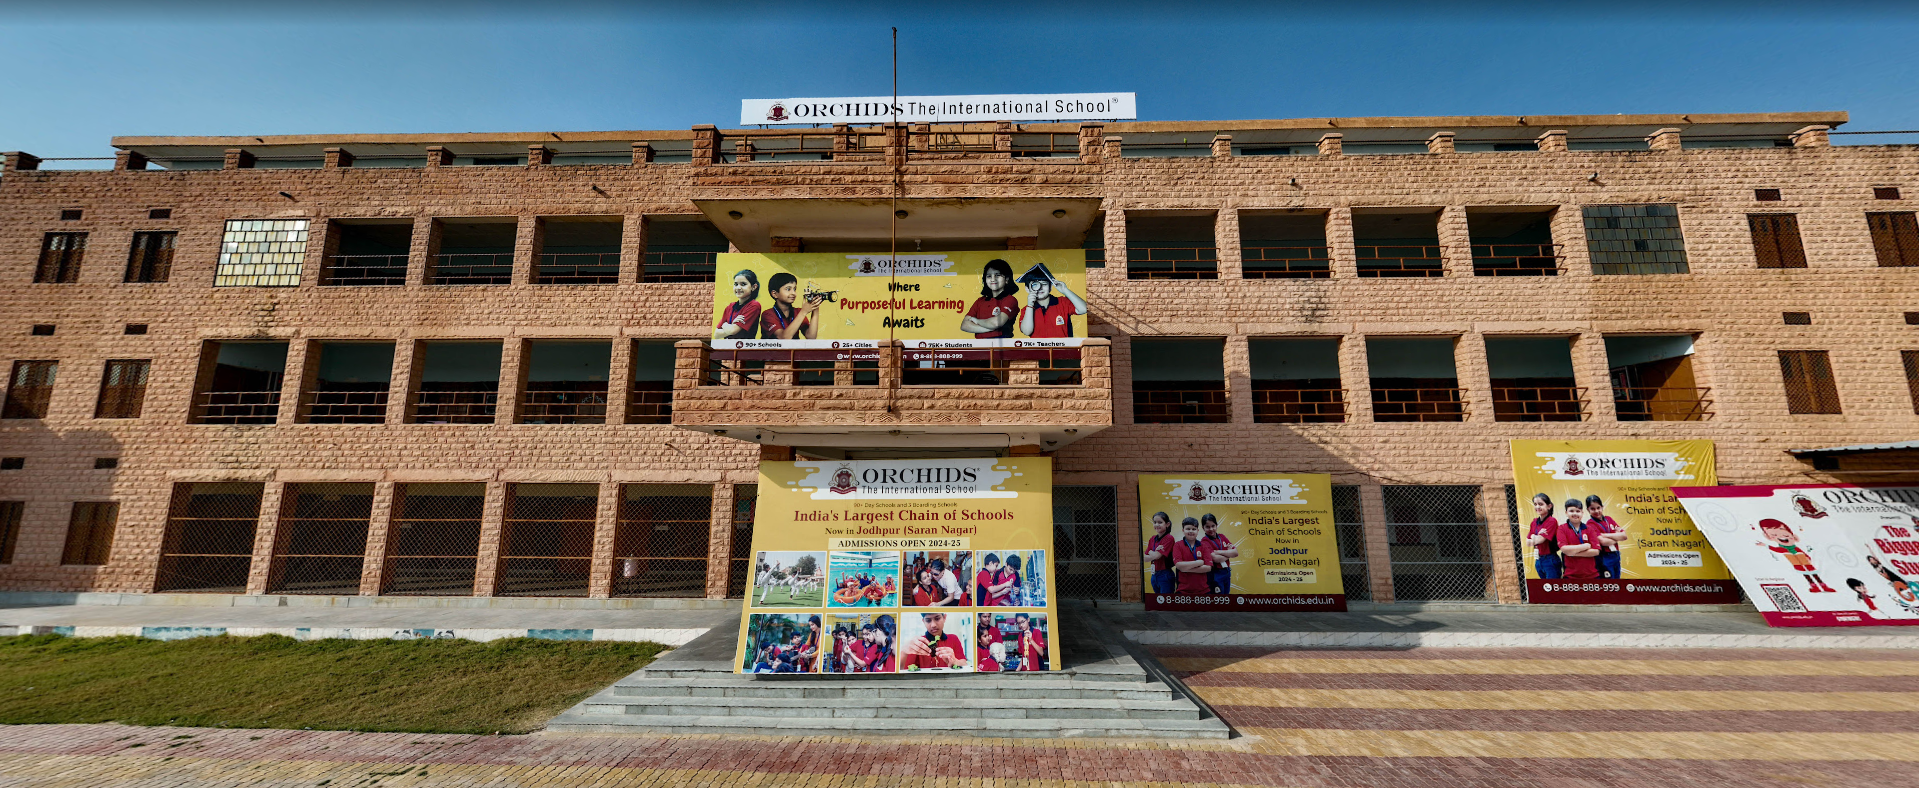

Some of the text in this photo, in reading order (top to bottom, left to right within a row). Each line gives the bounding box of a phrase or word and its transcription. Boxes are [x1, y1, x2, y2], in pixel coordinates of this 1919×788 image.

[793, 102, 904, 118] ORCHIDS
[908, 102, 936, 116] The
[942, 100, 1049, 115] International
[877, 259, 942, 269] ORCHIDS
[888, 282, 921, 292] Where
[840, 297, 965, 314] Purposeful Learning
[882, 316, 925, 329] Awaits
[1585, 457, 1666, 469] ORCHIDS
[862, 467, 977, 484] ORCHIDS
[1644, 469, 1668, 477] School
[862, 484, 977, 494] The International School
[1208, 485, 1281, 495] ORCHIDS
[1625, 493, 1660, 503] India's
[1823, 490, 1919, 504] ORCHID
[1626, 506, 1655, 515] Chain
[1657, 506, 1666, 514] of
[793, 508, 1014, 524] India's Largest Chain of Schools
[1248, 516, 1320, 526] India's Largest
[825, 525, 977, 537] Now in Jodhpur (Saran Nagar)
[1649, 527, 1692, 537] Jodhpur
[1881, 525, 1911, 538] The
[837, 540, 898, 548] ADMISSIONS
[1637, 539, 1706, 549] (Saran Nagar)
[1268, 547, 1309, 556] Jodhpur
[1257, 558, 1320, 567] (Saran Nagar)
[1553, 583, 1621, 592] 8-888-888-999
[1636, 583, 1723, 592] www.orchids.edu.in
[1165, 595, 1231, 605] 8-888-888-999
[1249, 595, 1335, 605] www.orchids.edu.in
